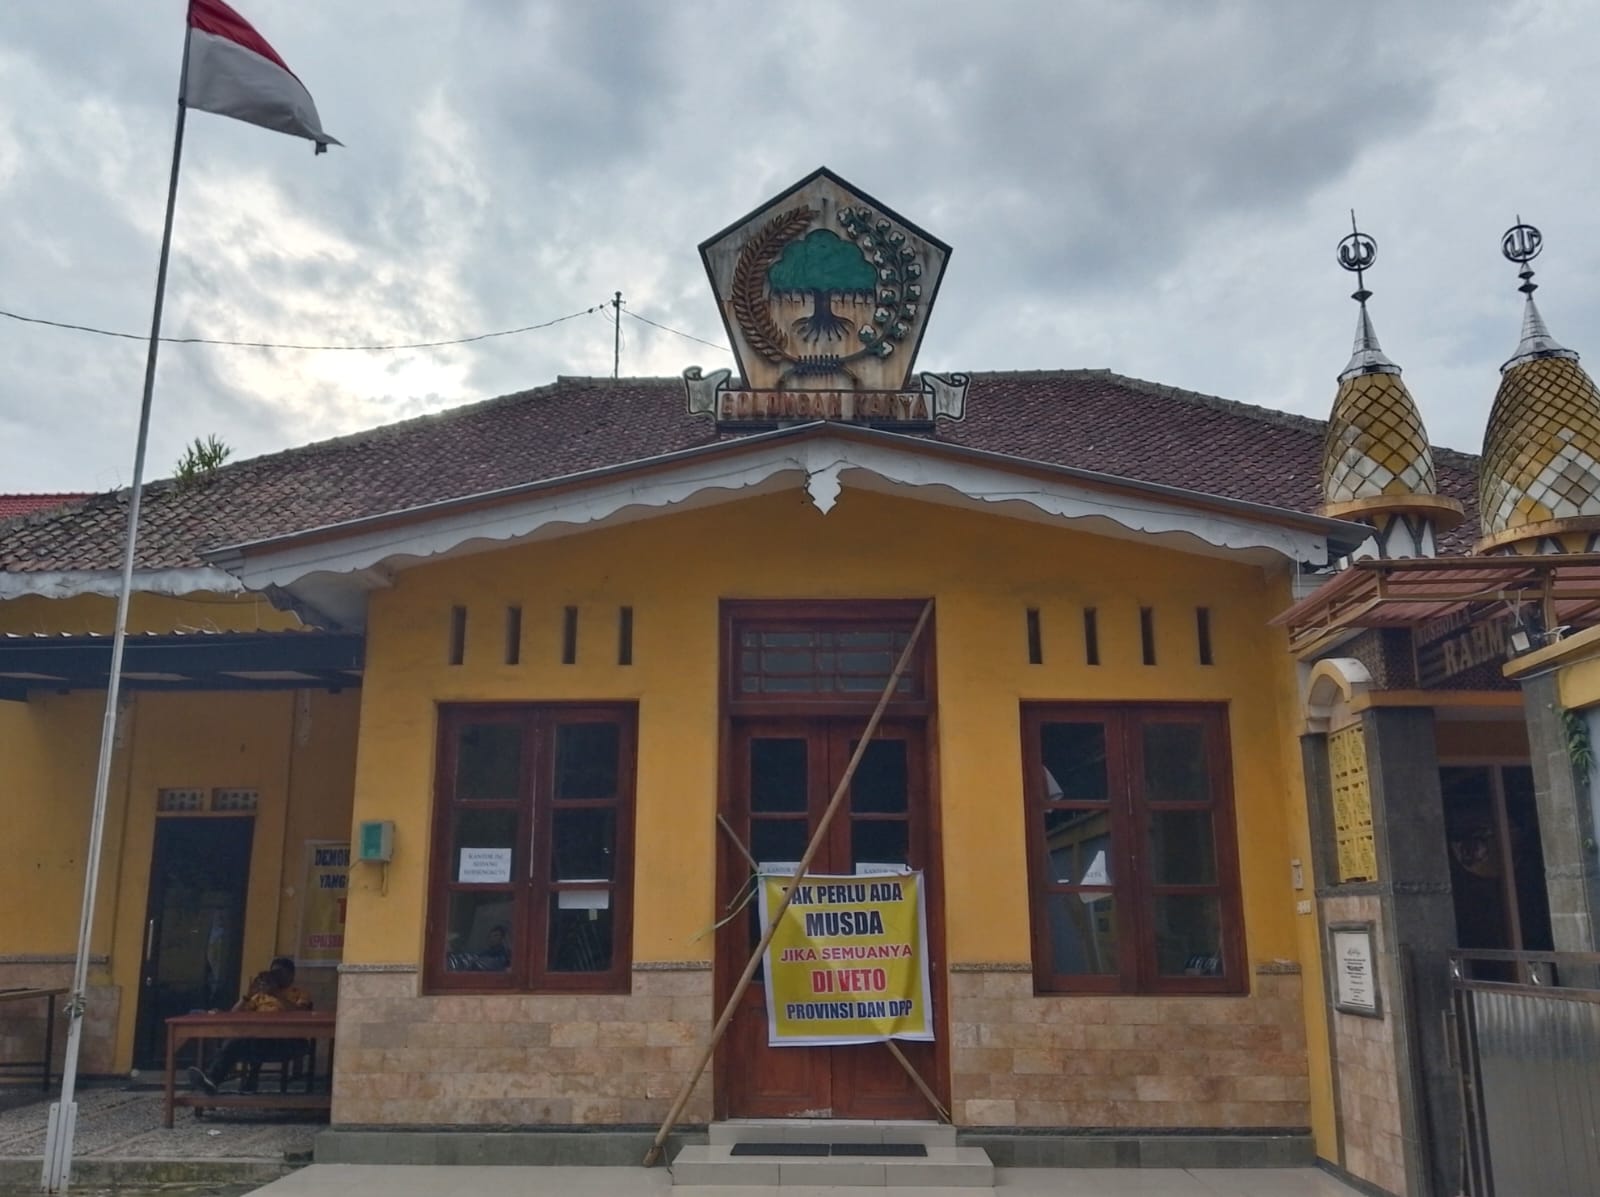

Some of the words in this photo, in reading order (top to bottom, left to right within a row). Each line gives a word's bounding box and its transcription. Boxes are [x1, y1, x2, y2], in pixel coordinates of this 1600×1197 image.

[853, 393, 929, 419] KARYA
[320, 874, 346, 888] YANG
[782, 885, 813, 905] AK
[817, 883, 866, 903] PERLU
[870, 883, 903, 902] ADA
[806, 911, 884, 937] MUSDA
[781, 948, 817, 962] JIKA
[822, 944, 913, 960] SEMUANYA
[812, 971, 833, 993] DI
[838, 968, 886, 992] VETO
[787, 1002, 854, 1020] PROVINSI
[857, 1001, 886, 1018] DAN
[889, 1000, 912, 1017] DPP
